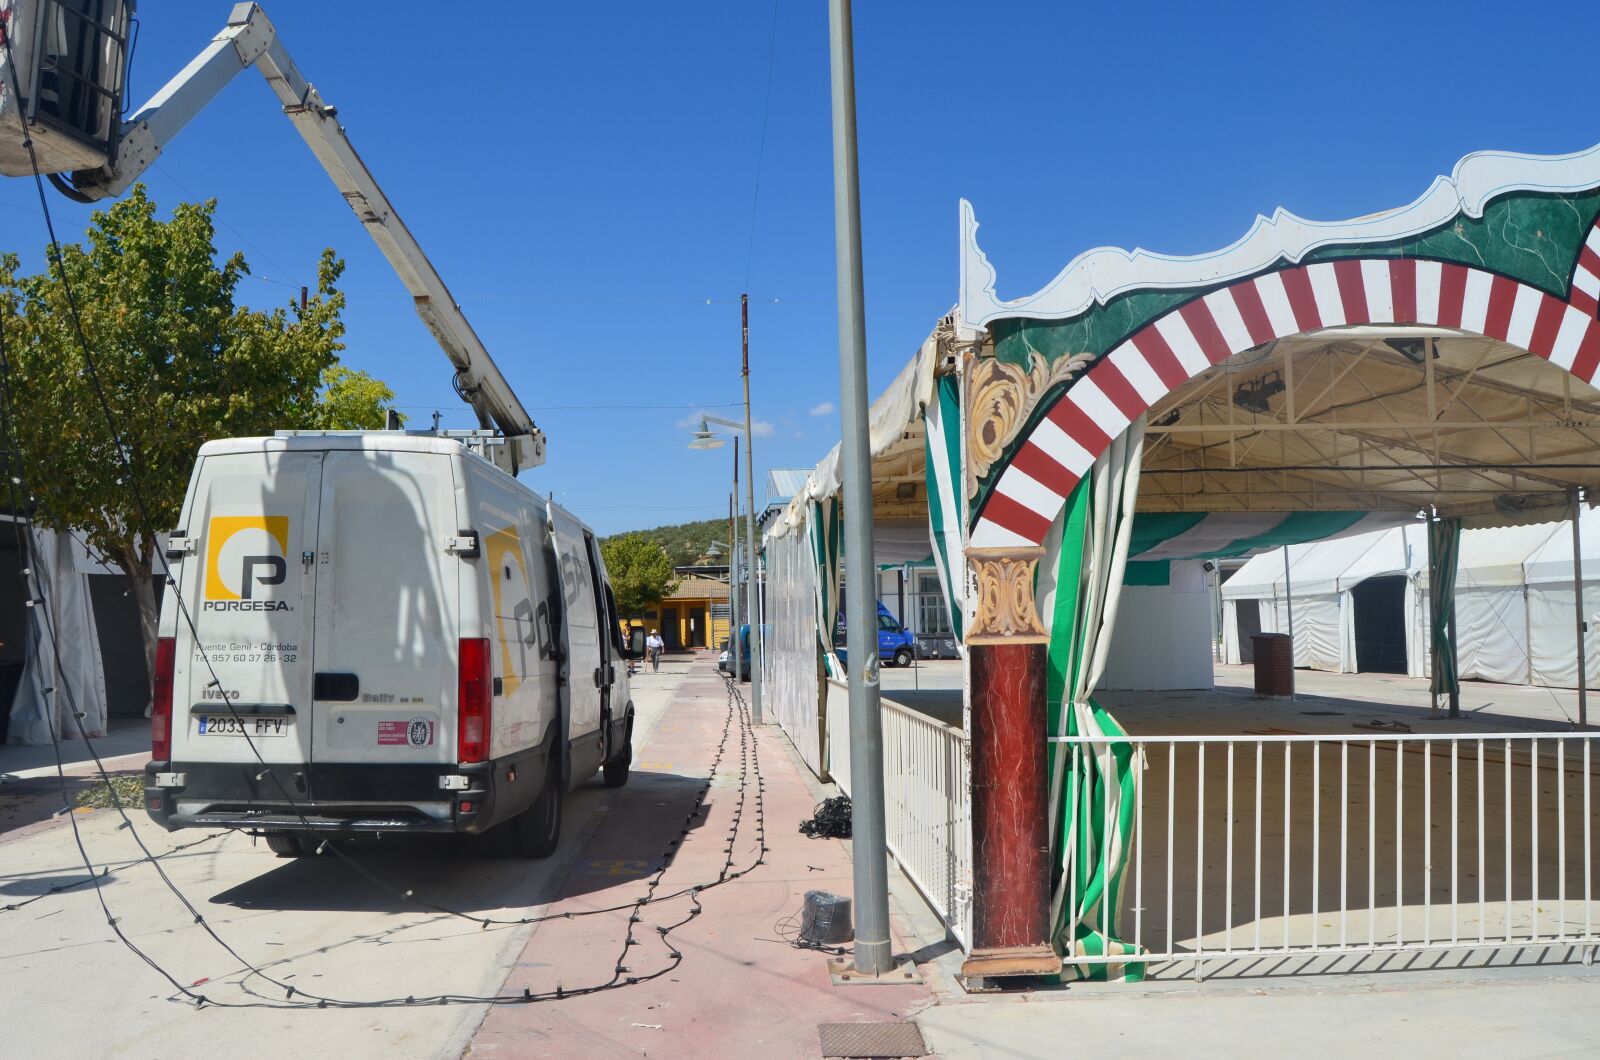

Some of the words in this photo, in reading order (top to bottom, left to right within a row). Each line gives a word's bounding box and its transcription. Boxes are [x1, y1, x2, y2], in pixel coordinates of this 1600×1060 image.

[241, 555, 287, 600] P
[203, 600, 289, 612] PORGESA
[229, 642, 252, 651] Genil
[260, 642, 298, 651] Córdoba
[211, 654, 232, 663] 957
[233, 654, 246, 663] 60
[248, 654, 261, 663] 37
[263, 654, 277, 663] 26
[283, 654, 297, 663] 32
[201, 688, 240, 700] IVECO
[207, 717, 245, 733] 2033
[255, 718, 283, 734] FFV
